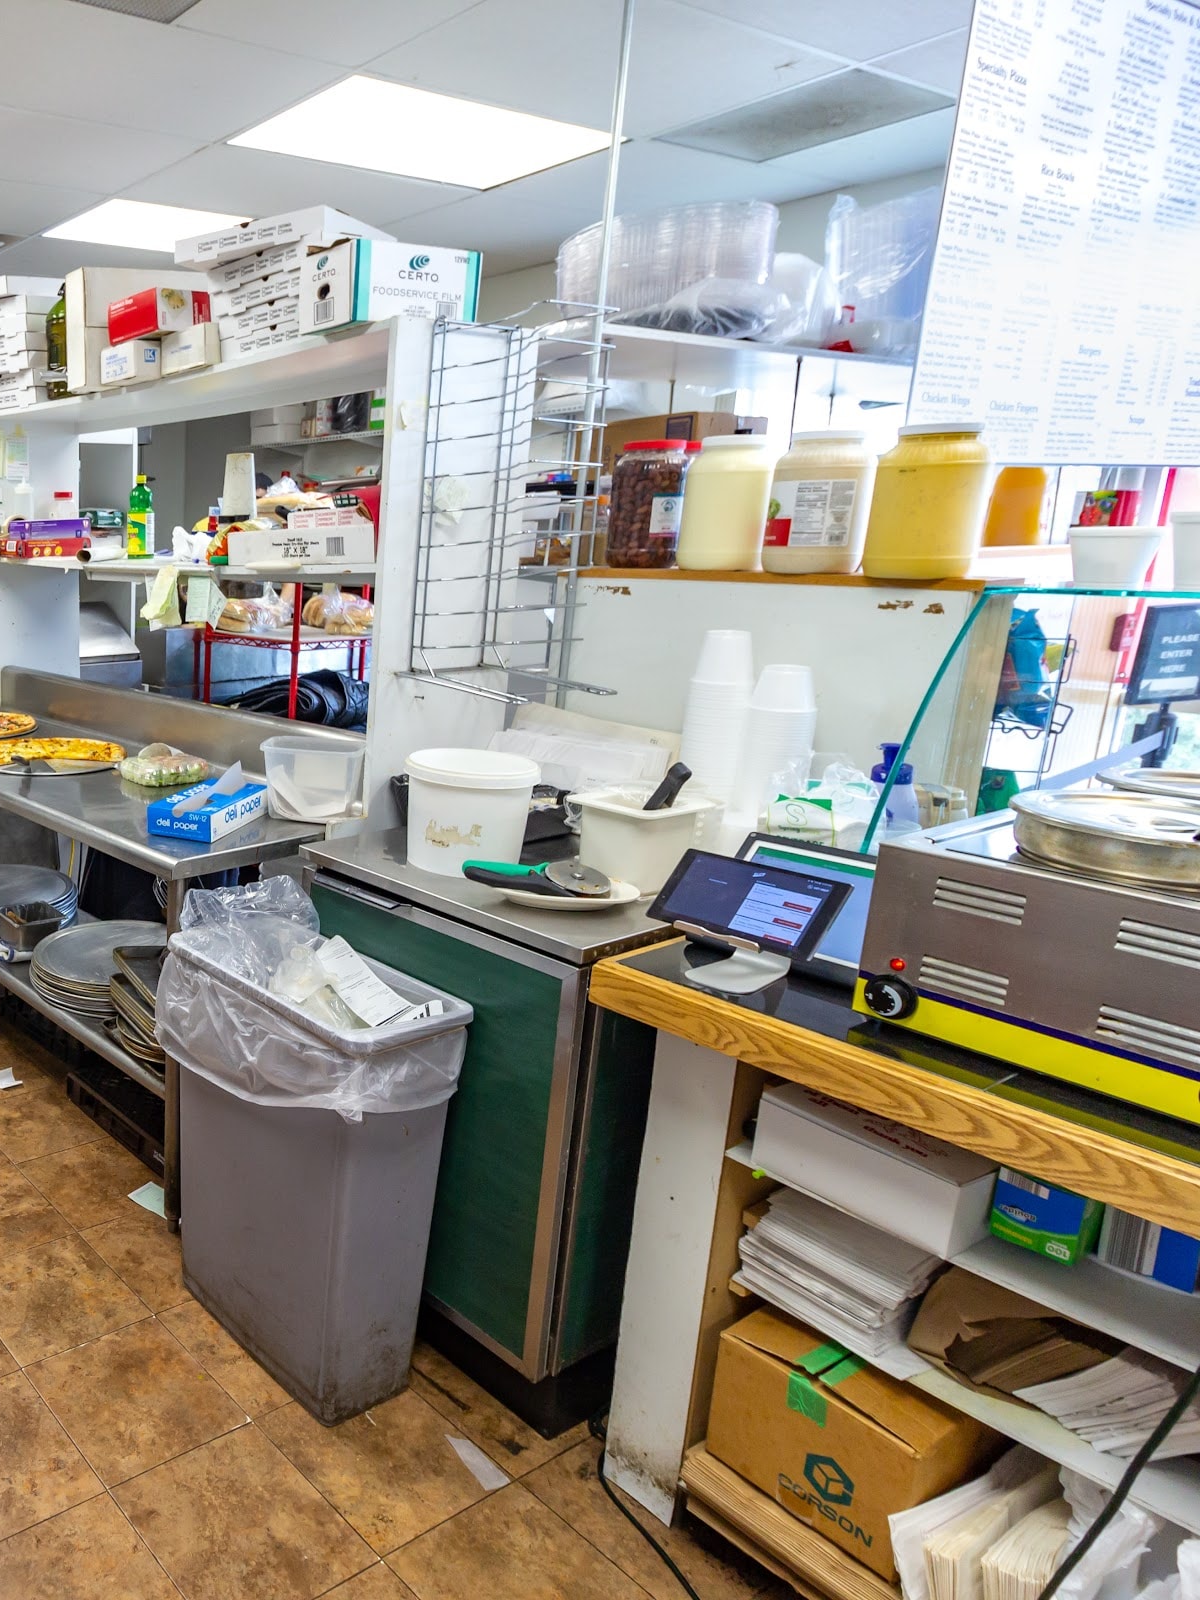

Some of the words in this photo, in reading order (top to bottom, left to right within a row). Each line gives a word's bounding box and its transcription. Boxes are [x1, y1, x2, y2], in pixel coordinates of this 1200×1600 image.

[977, 56, 1007, 81] Specialty
[1010, 69, 1027, 86] Pizza
[312, 268, 336, 282] CERTO
[398, 270, 439, 282] CERTO
[372, 286, 438, 300] FOODSERVICE
[441, 292, 462, 301] FILM
[922, 391, 948, 403] Chicken
[951, 393, 970, 407] Wings
[990, 400, 1015, 412] Chicken
[1016, 402, 1039, 414] Fingers
[1161, 633, 1200, 644] PLEASE
[1160, 649, 1193, 659] ENTER
[1159, 664, 1186, 674] HERE
[224, 807, 238, 823] deli
[240, 796, 261, 818] paper
[156, 818, 170, 827] deli
[173, 821, 198, 831] paper
[188, 813, 207, 822] SW-12
[863, 1125, 900, 1145] thank
[902, 1144, 928, 1158] you
[1046, 1244, 1069, 1259] 100
[778, 1472, 873, 1548] CORSON
